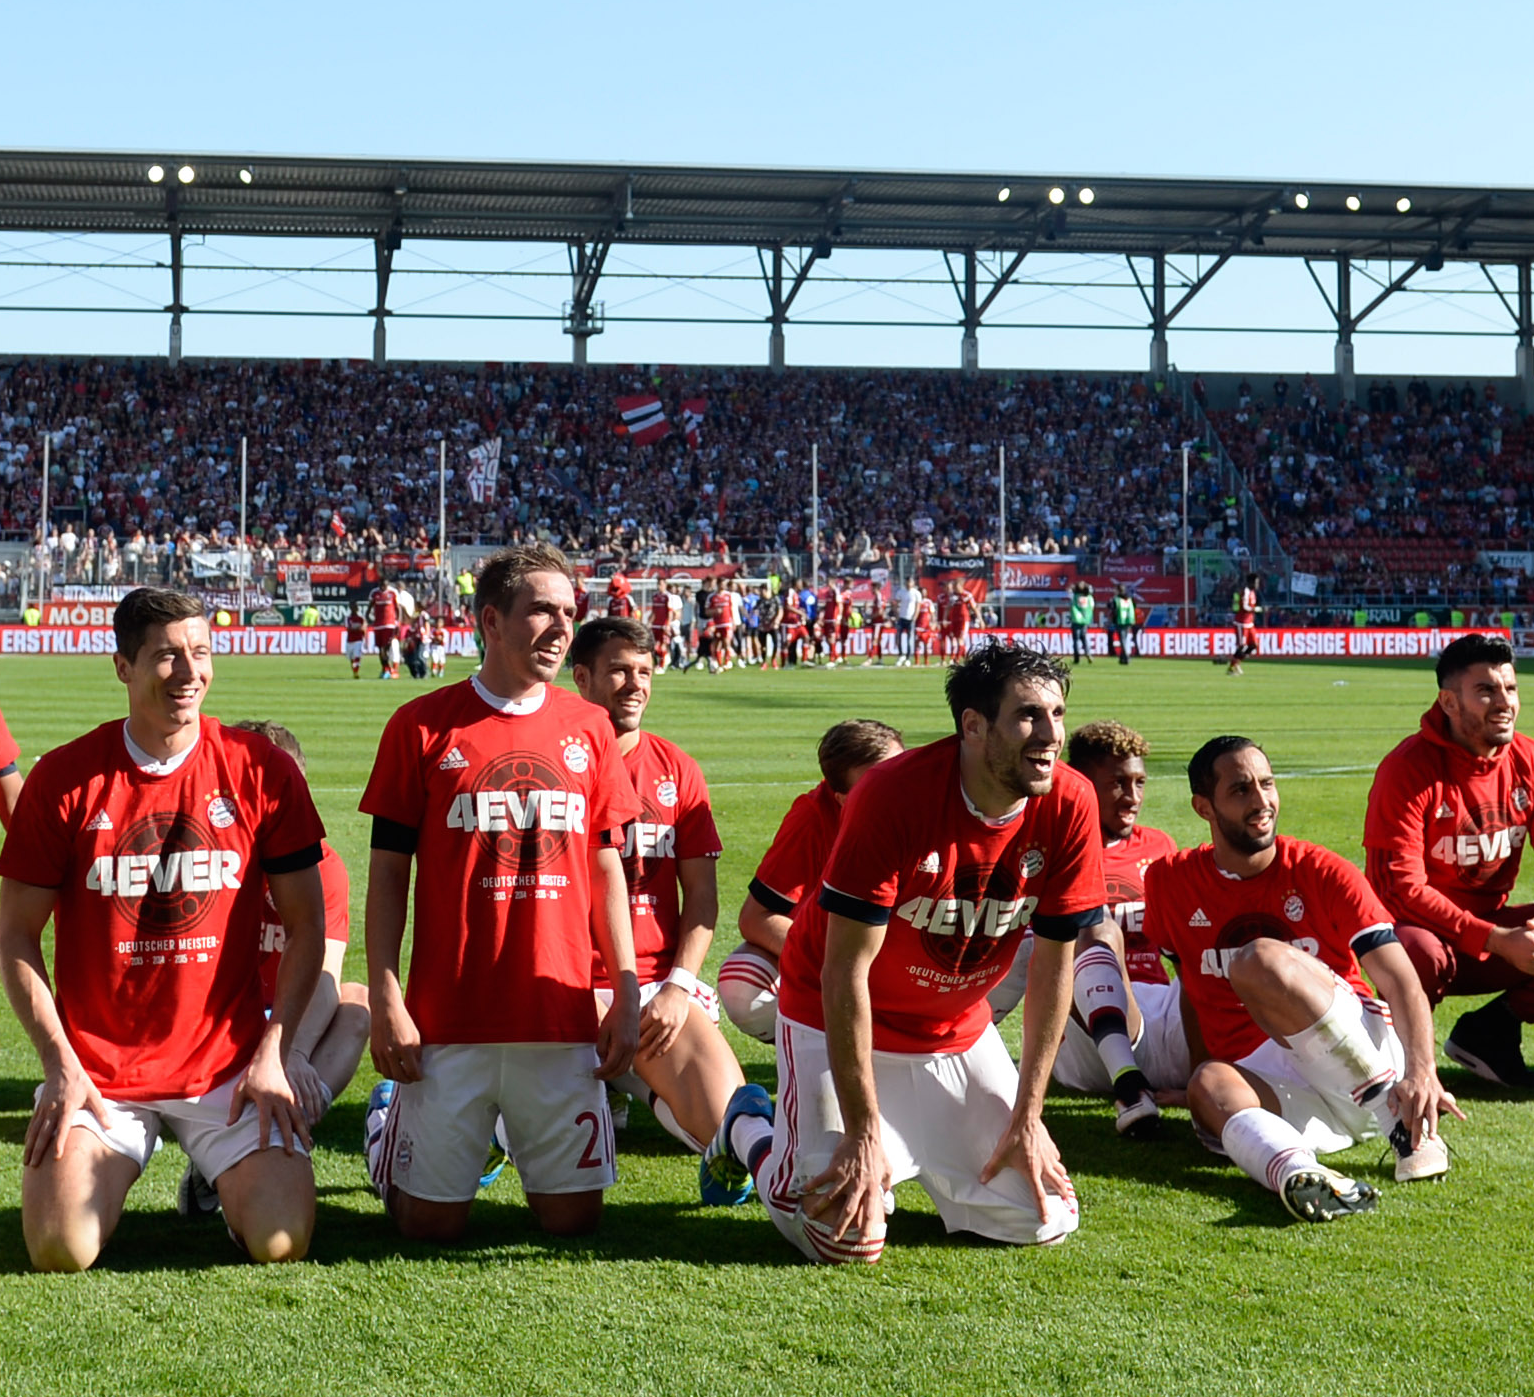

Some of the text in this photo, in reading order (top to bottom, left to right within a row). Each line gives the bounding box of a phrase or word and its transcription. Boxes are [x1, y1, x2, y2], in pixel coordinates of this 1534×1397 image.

[2, 631, 117, 654] ERSTKLASS
[212, 626, 327, 654] STÜTZUNG!
[1012, 632, 1108, 655] SCHANER
[1164, 632, 1209, 655] EURE
[1213, 632, 1345, 656] ERTKLASSIGE
[439, 759, 470, 770] adidas
[447, 790, 586, 834] 4EVER
[86, 821, 113, 831] adidas
[86, 850, 242, 897] 4EVER
[482, 874, 567, 888] DEUTSCHER MEISTER
[896, 896, 1039, 938] 4EVER
[118, 936, 217, 954] DEUTSCHER MEISTER
[909, 965, 966, 985] DEUTSCHER
[1087, 985, 1115, 998] FCB
[575, 1111, 602, 1170] 2
